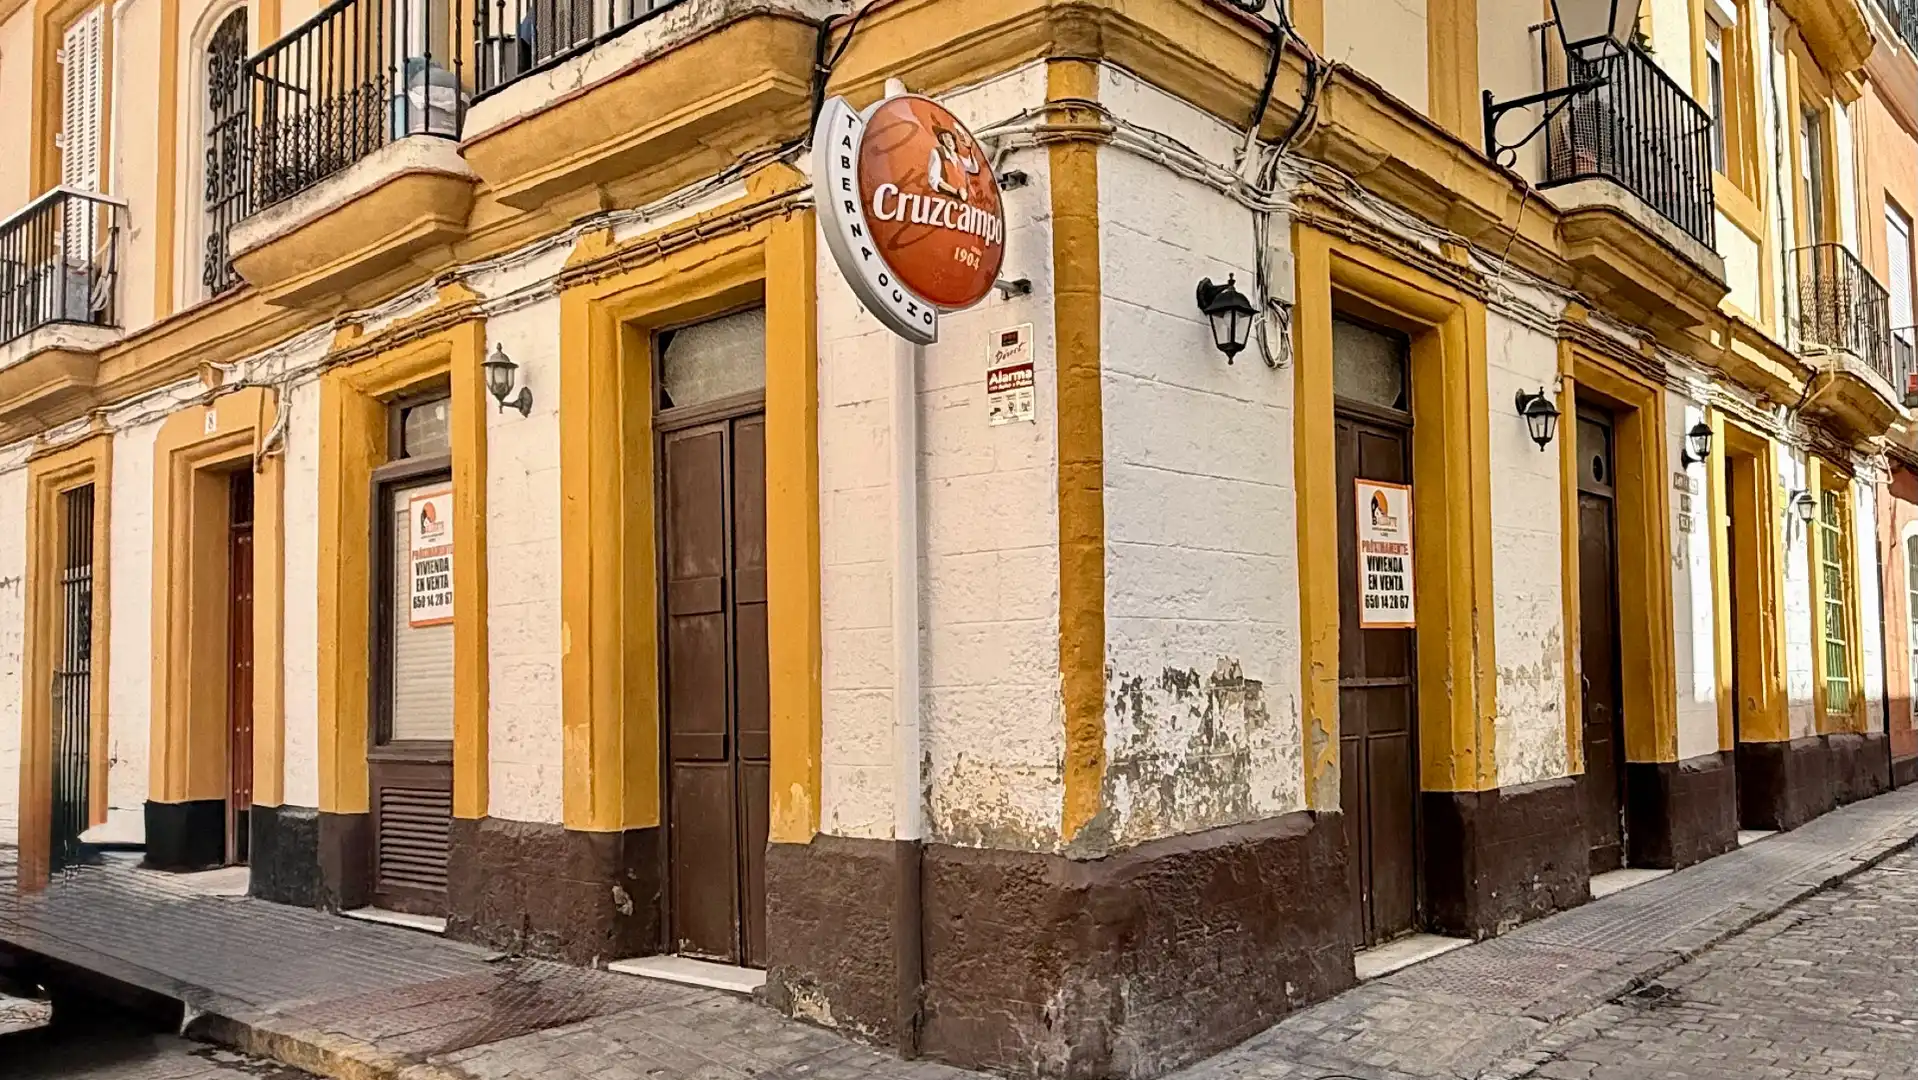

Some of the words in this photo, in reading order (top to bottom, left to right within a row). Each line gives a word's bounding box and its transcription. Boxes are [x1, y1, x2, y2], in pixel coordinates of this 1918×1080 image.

[841, 114, 872, 261] TABERNA
[878, 273, 934, 325] OCHO
[873, 183, 1003, 247] Cruzcampo
[954, 246, 980, 271] 1904
[989, 369, 1032, 385] Alarma
[208, 412, 214, 430] 8
[415, 557, 449, 576] VIVIENDA
[1367, 555, 1403, 573] VIVIENDA
[416, 577, 425, 592] EN
[426, 574, 449, 591] VENTA
[1368, 574, 1378, 590] EN
[1380, 574, 1404, 591] VENTA
[413, 595, 426, 609] 650
[427, 594, 435, 607] 14
[435, 592, 443, 606] 28
[444, 591, 453, 605] 67
[1365, 594, 1380, 609] 650
[1381, 595, 1388, 609] 14
[1389, 595, 1399, 609] 28
[1399, 595, 1409, 610] 67
